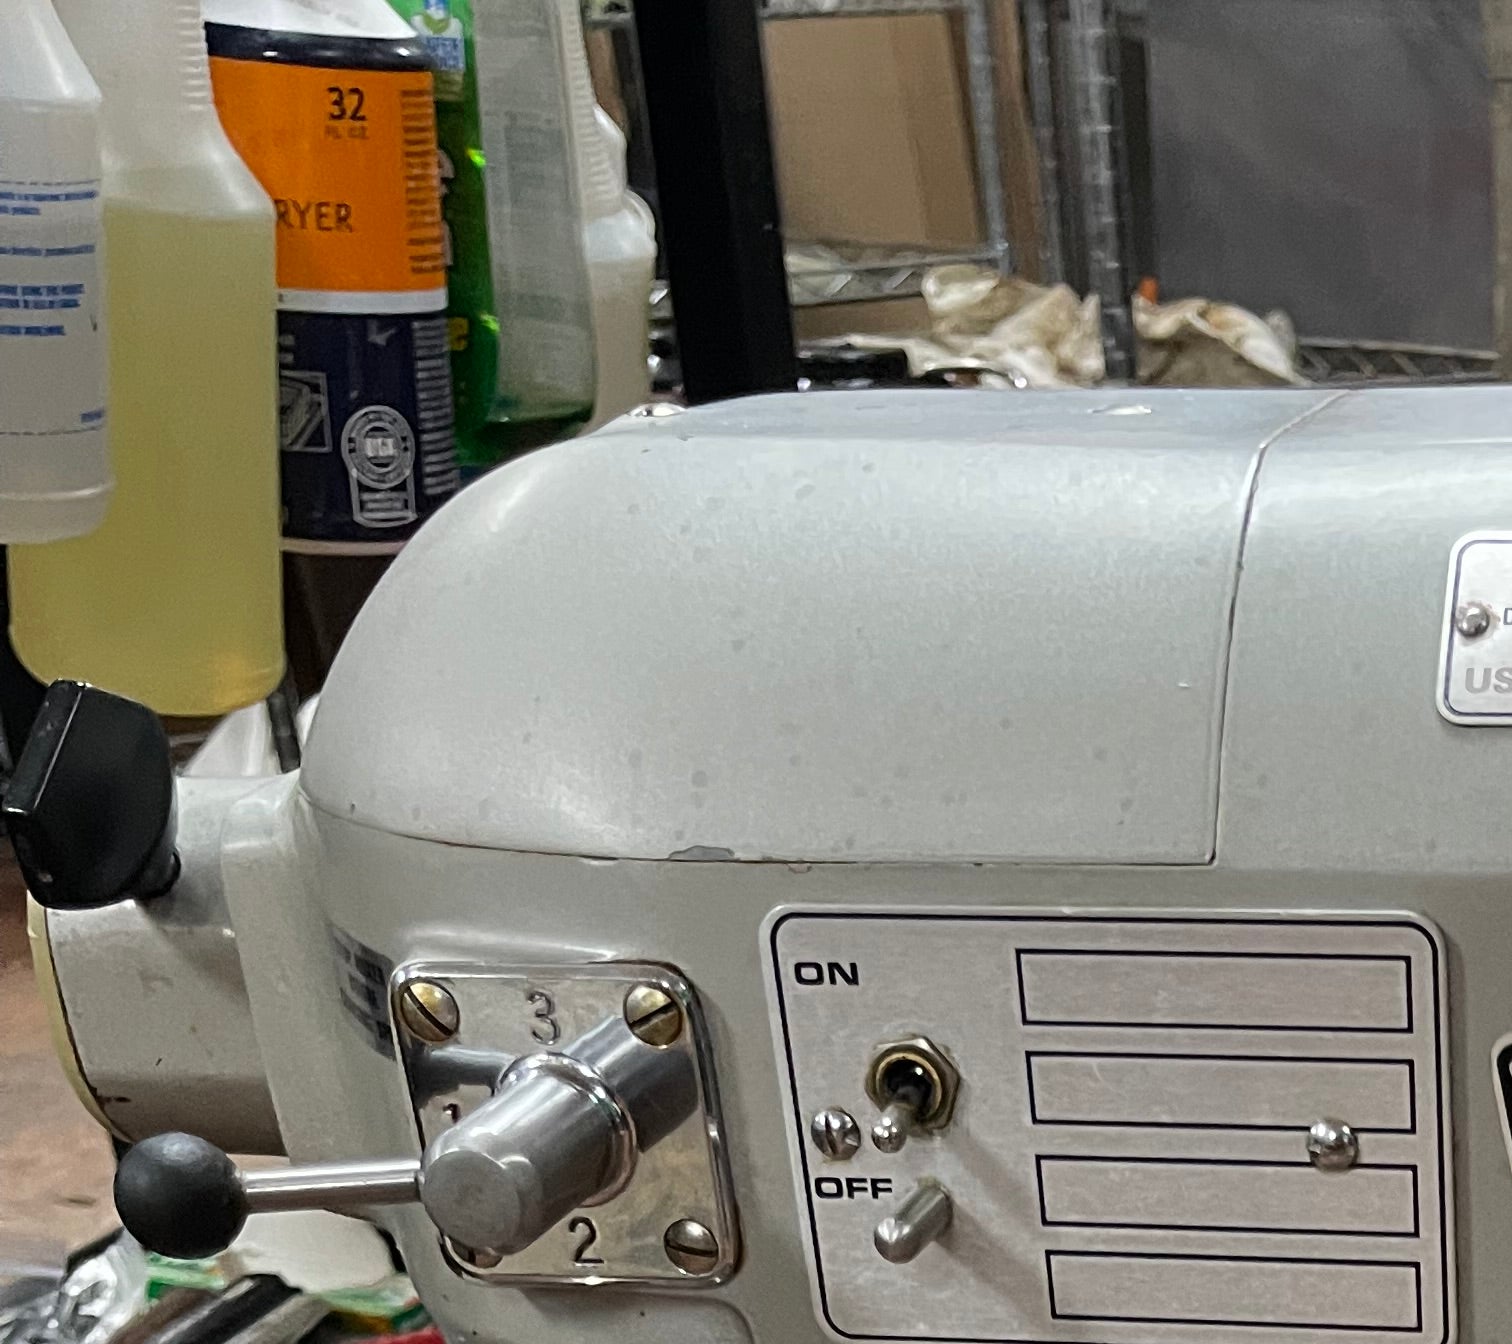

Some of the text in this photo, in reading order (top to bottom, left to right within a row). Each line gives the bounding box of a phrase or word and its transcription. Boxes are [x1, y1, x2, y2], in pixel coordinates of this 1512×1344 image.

[327, 86, 367, 121] 32
[794, 962, 859, 986] ON
[526, 991, 558, 1045] 3
[814, 1176, 893, 1199] OFF
[568, 1215, 604, 1264] 2
